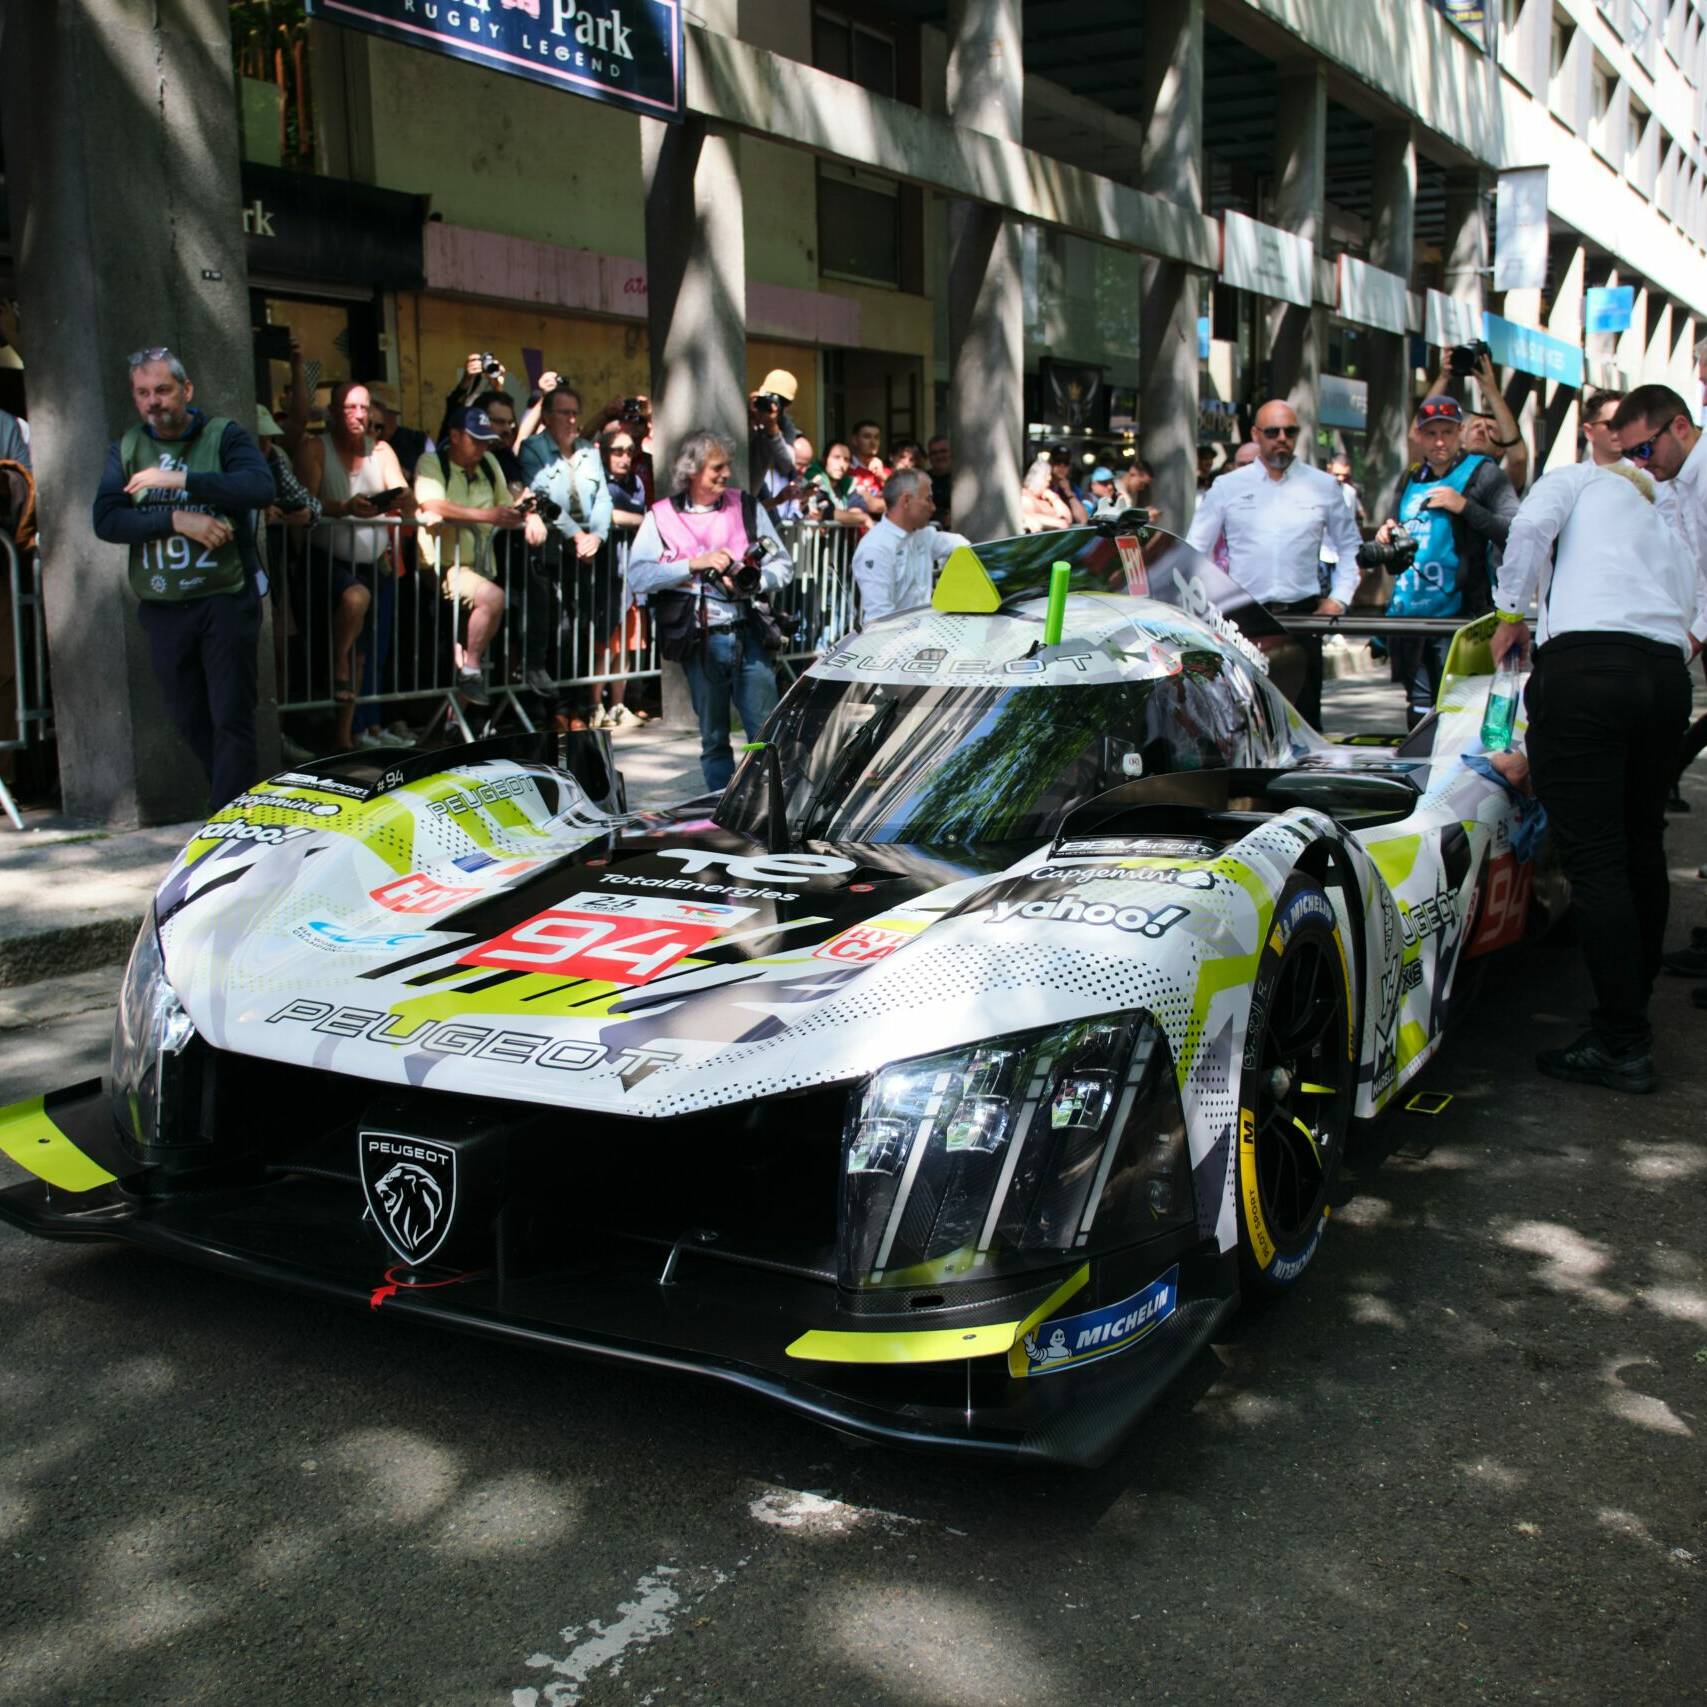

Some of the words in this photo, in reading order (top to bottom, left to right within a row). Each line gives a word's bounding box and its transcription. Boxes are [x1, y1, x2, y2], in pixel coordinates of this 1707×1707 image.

[403, 0, 499, 38] RUGBY
[522, 34, 620, 77] LEGEND
[426, 774, 537, 824] PEUGEOT
[599, 872, 801, 901] TotalEnergies
[1031, 866, 1178, 885] Capgemini
[983, 895, 1191, 939] yahoo!
[1290, 895, 1332, 927] MICHELIN
[479, 916, 688, 977] 94
[264, 998, 684, 1078] PEUGEOT
[368, 1141, 449, 1165] PEUGEOT
[1249, 1189, 1261, 1230] SPORT
[1075, 1286, 1169, 1349] MICHELIN
